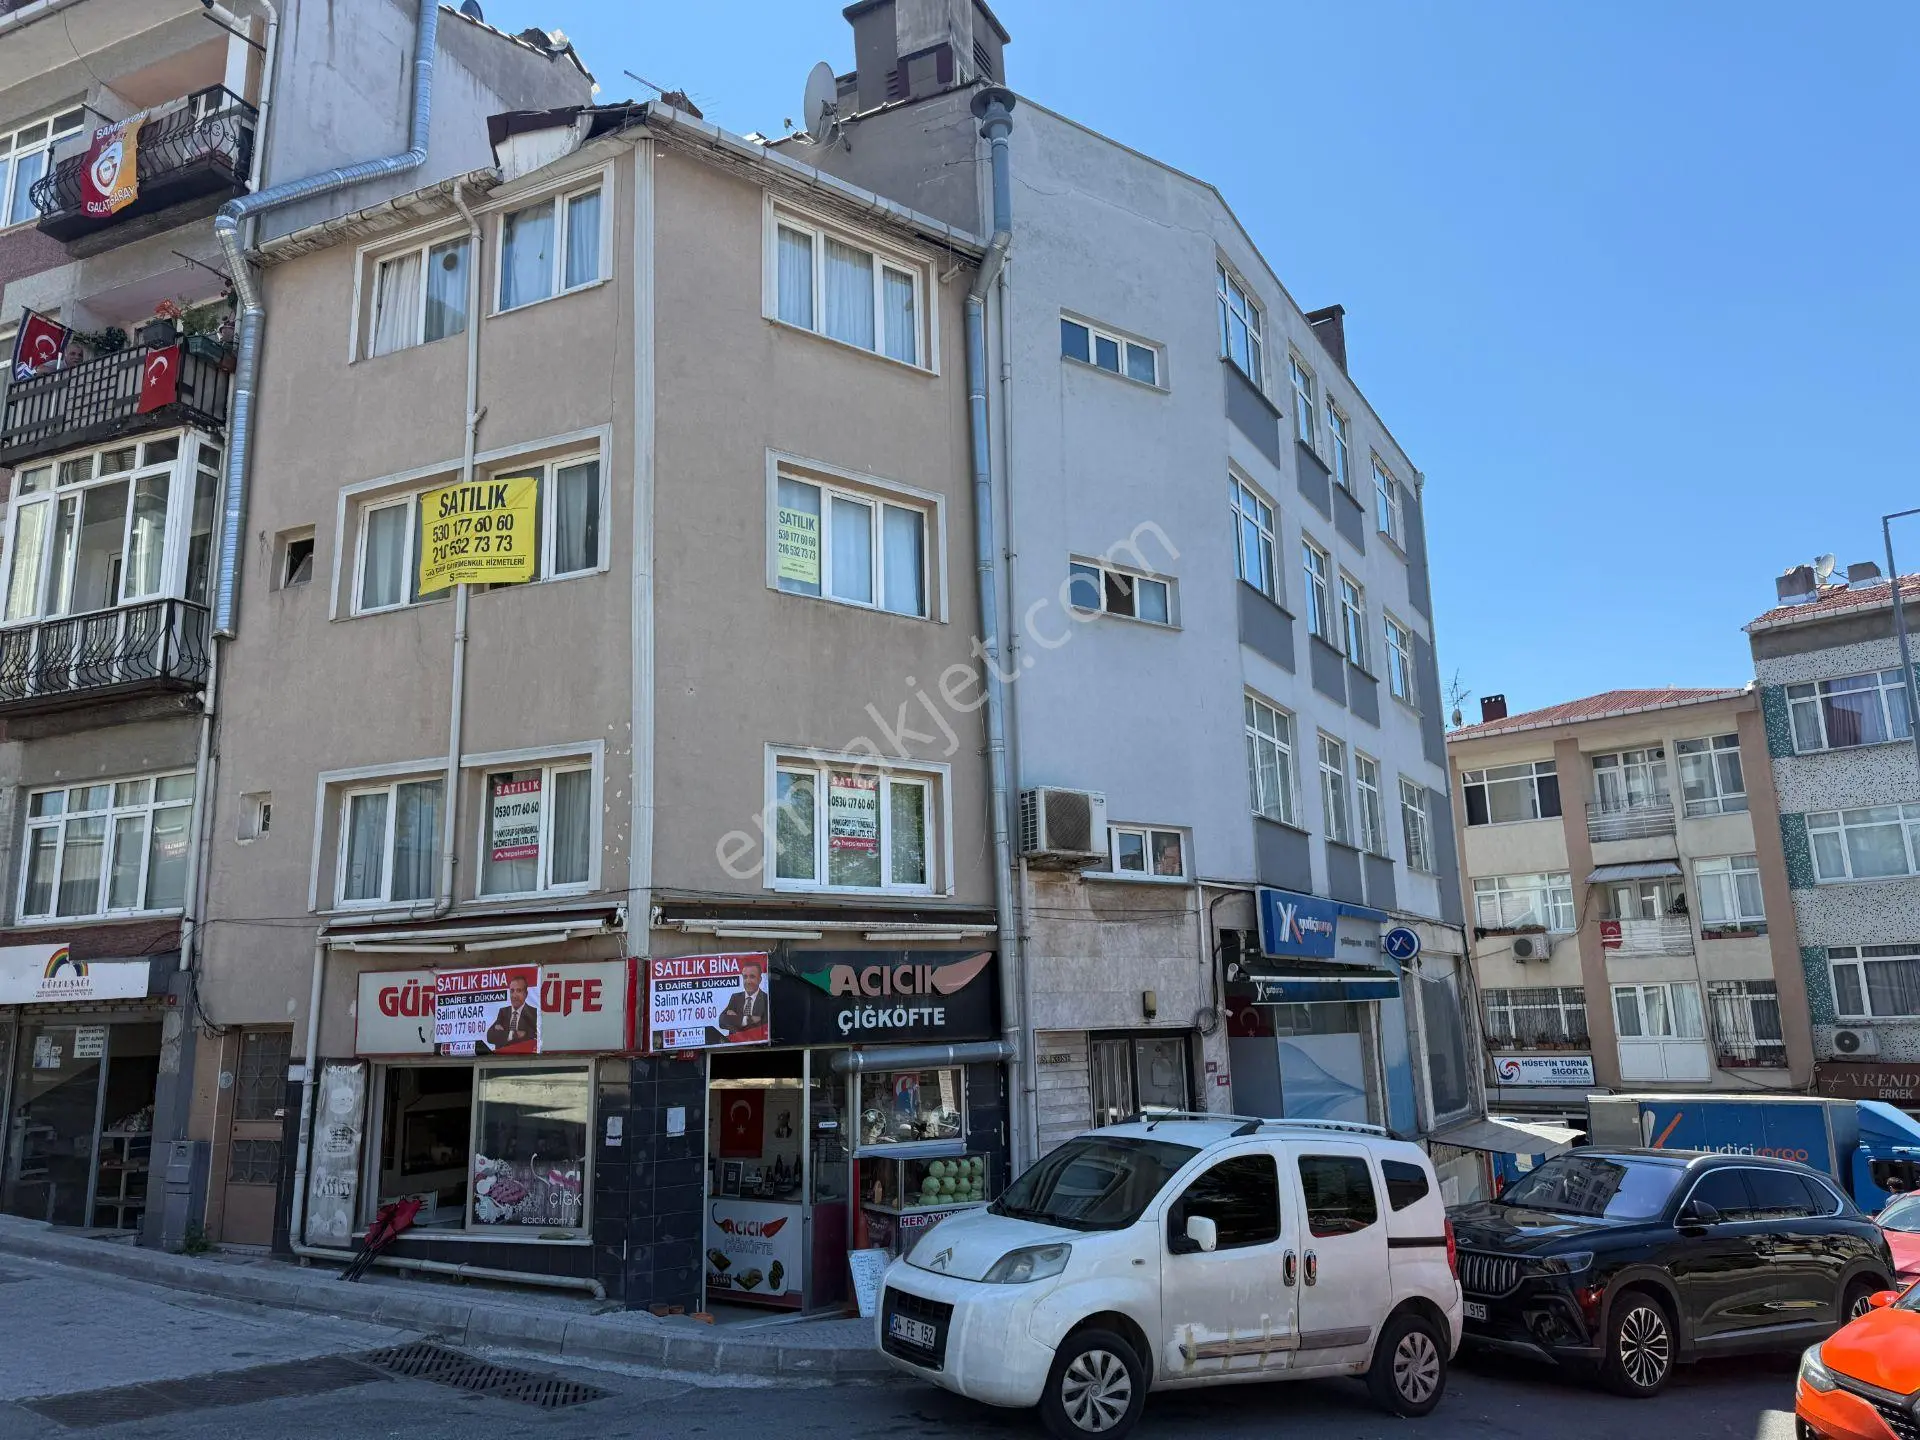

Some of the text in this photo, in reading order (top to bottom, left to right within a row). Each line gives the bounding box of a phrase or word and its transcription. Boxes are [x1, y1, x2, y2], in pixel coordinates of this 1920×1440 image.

[439, 484, 508, 518] SATILIK
[433, 514, 514, 543] 530 177 60 60
[779, 511, 815, 531] SATILIK
[474, 536, 490, 553] 73
[496, 535, 513, 552] 73
[791, 532, 800, 543] 177
[485, 556, 525, 566] HİZMETLERİ
[809, 549, 816, 560] 73
[496, 780, 539, 795] SATILIK
[832, 776, 874, 789] SATILIK
[495, 801, 539, 818] 0530 177 60 60
[831, 795, 847, 808] 0530
[858, 798, 866, 809] 60
[866, 799, 875, 810] 60
[655, 955, 740, 977] SATILIK BİNA
[437, 969, 508, 992] SATILIK BİNA
[665, 981, 692, 990] DAİRE
[702, 978, 738, 988] DÜKKAN
[446, 995, 467, 1005] DAİRE
[474, 993, 506, 1003] DÜKKAN
[655, 991, 713, 1007] Salim KASAR
[436, 1006, 484, 1021] Salim KASAR
[655, 1006, 717, 1023] 0530 177 60 60
[837, 1004, 945, 1036] ÇİĞKÖFTE
[436, 1020, 486, 1036] 0530 177 60 60
[1521, 1059, 1558, 1067] HÜSEYİN
[1879, 1088, 1913, 1099] ERKEK
[901, 1216, 924, 1227] HER
[1470, 1304, 1485, 1318] 915
[893, 1315, 902, 1331] 34
[906, 1320, 915, 1338] FE
[920, 1323, 934, 1344] 152
